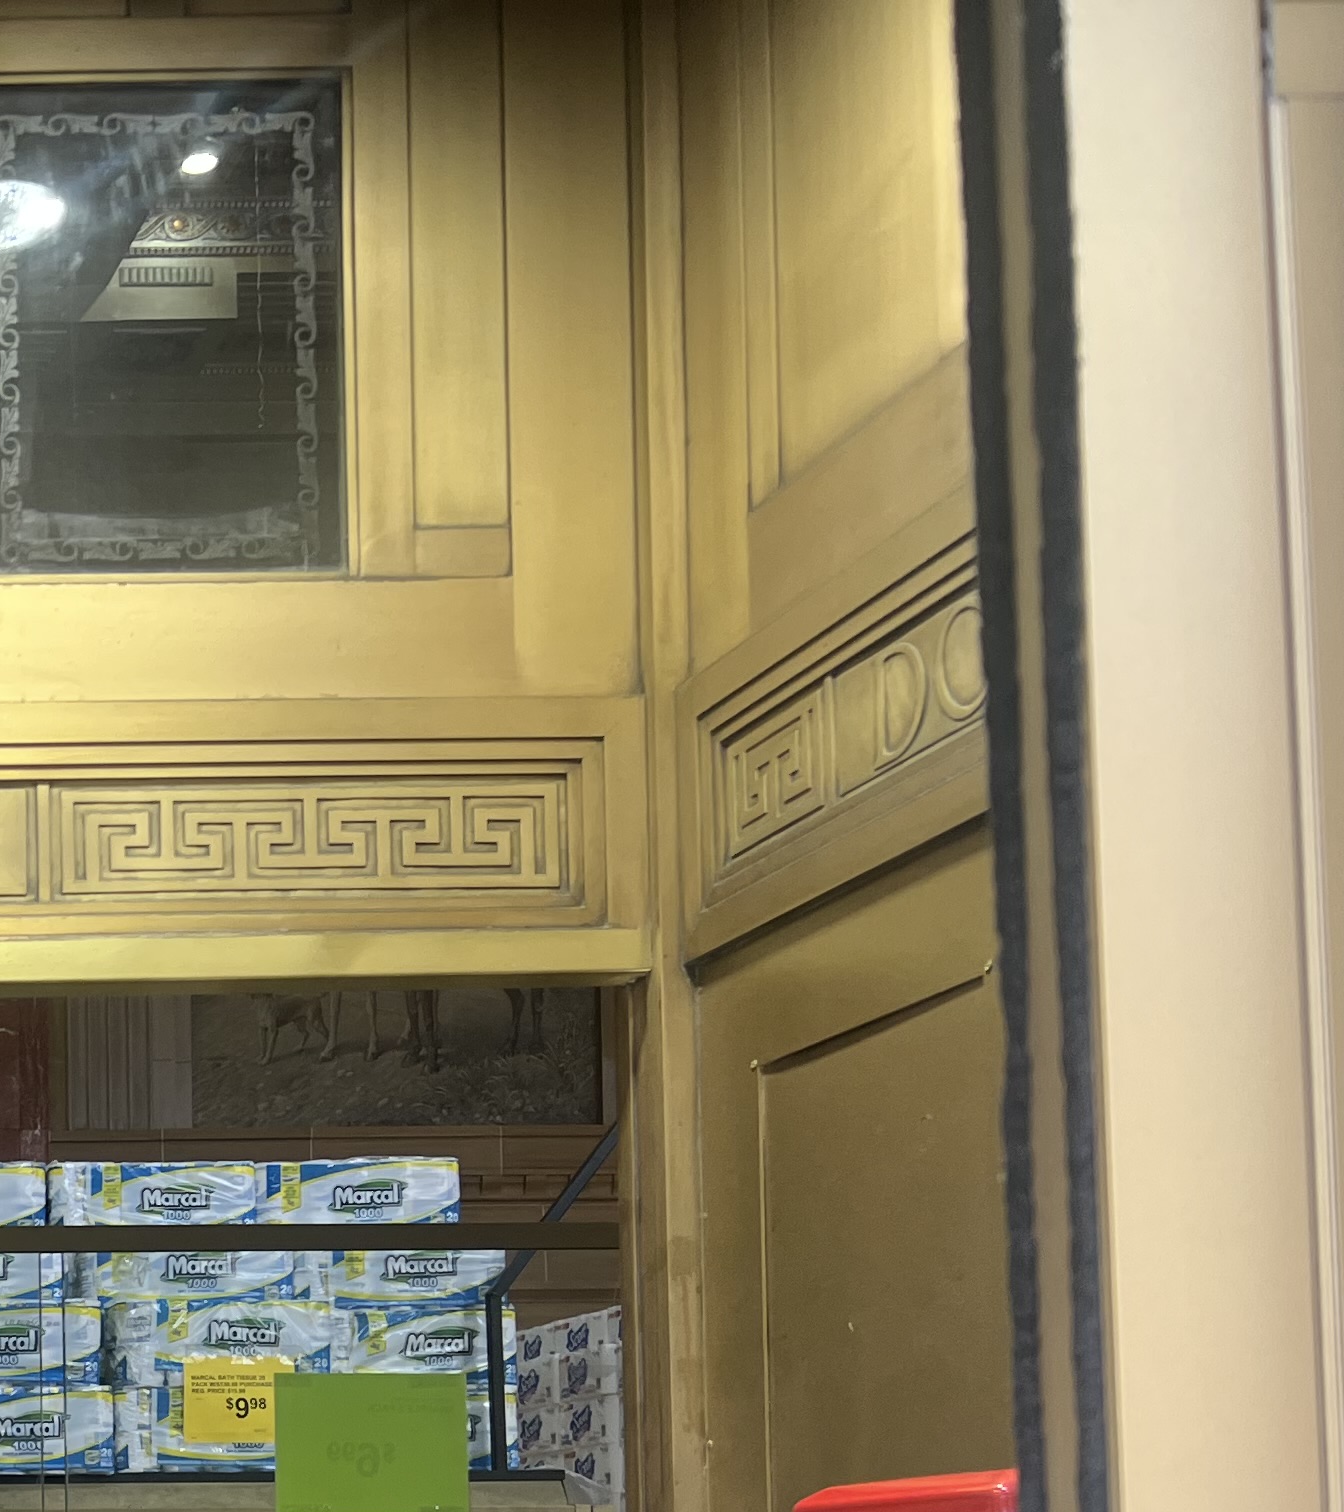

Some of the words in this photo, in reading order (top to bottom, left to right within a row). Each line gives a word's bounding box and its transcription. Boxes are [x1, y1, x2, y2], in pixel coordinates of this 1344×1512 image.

[141, 1186, 210, 1213] Marcal
[334, 1184, 402, 1209] Marcal
[162, 1210, 192, 1221] 1000
[353, 1207, 383, 1219] 1000
[166, 1255, 235, 1278] Marcal
[385, 1254, 455, 1278] Marcal
[186, 1278, 218, 1289] 1000
[209, 1319, 279, 1346] Marcal
[405, 1333, 473, 1358] Marcal
